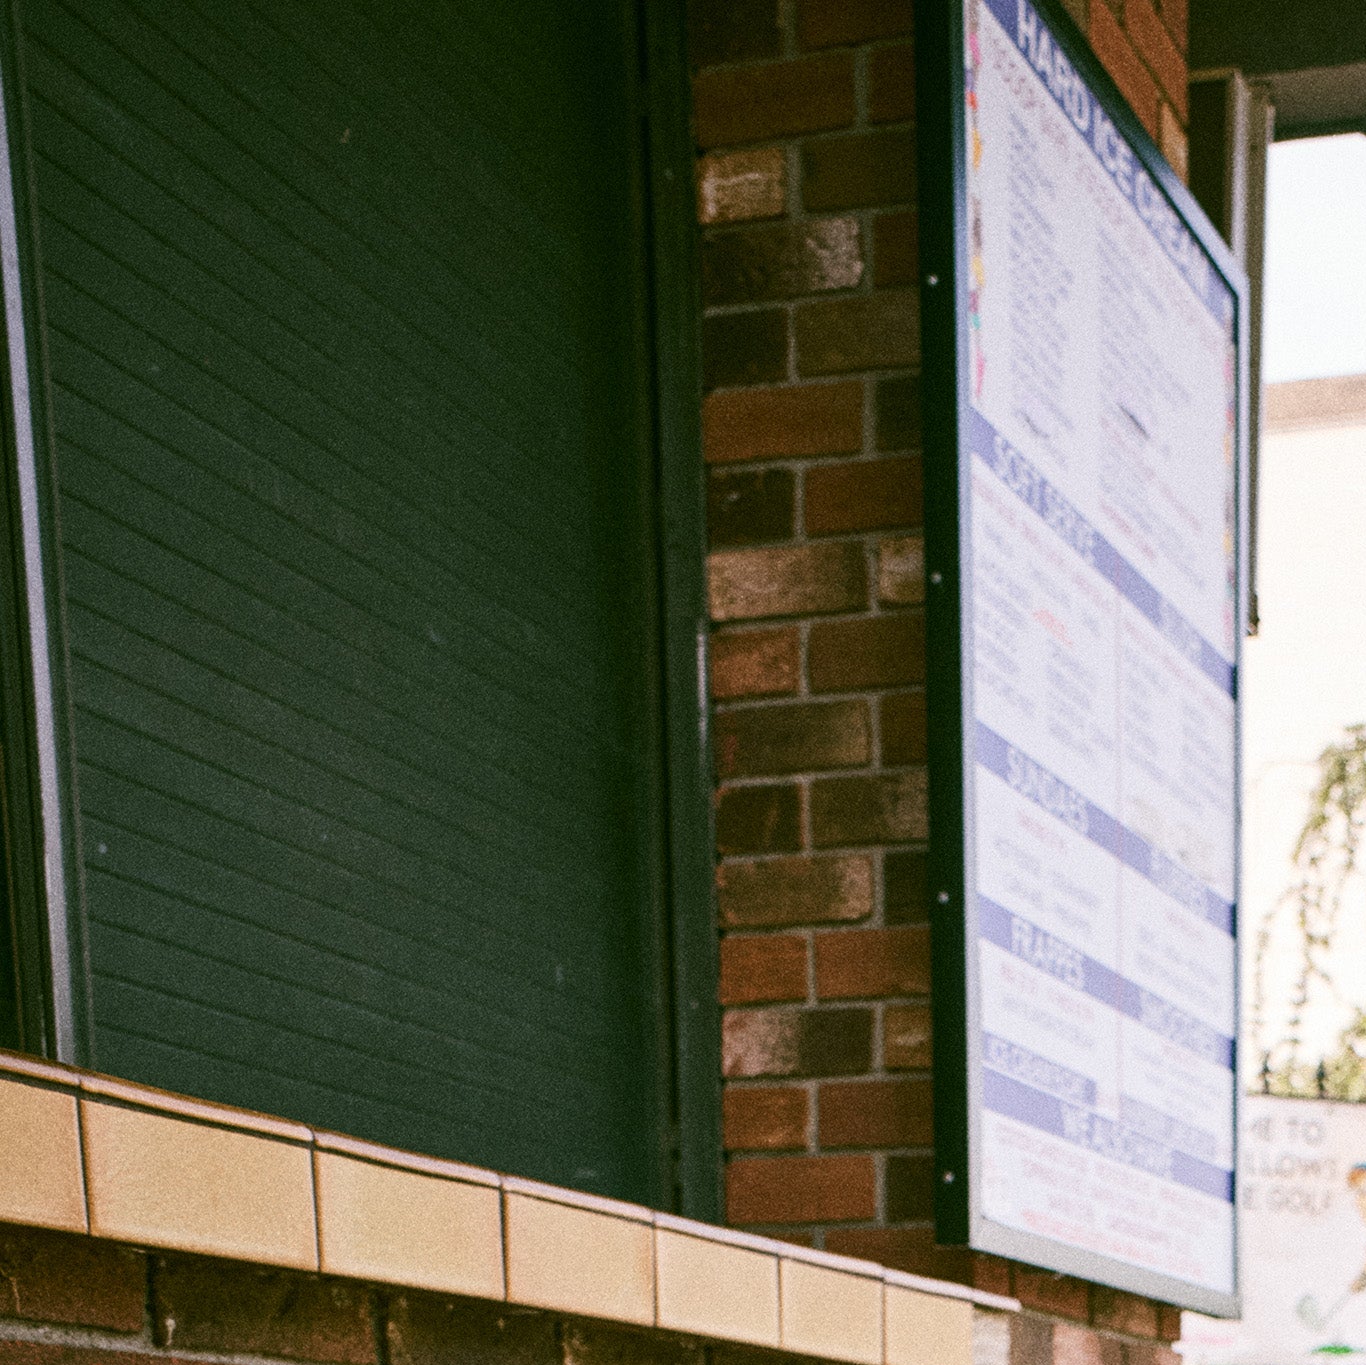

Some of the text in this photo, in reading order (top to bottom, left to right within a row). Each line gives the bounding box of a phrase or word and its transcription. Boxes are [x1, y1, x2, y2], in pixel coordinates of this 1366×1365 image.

[1016, 2, 1089, 137] HARD
[1093, 108, 1131, 198] ICE
[1135, 166, 1208, 301] CREAM
[994, 433, 1042, 512] SOFT
[1011, 915, 1085, 991] FRAPPES
